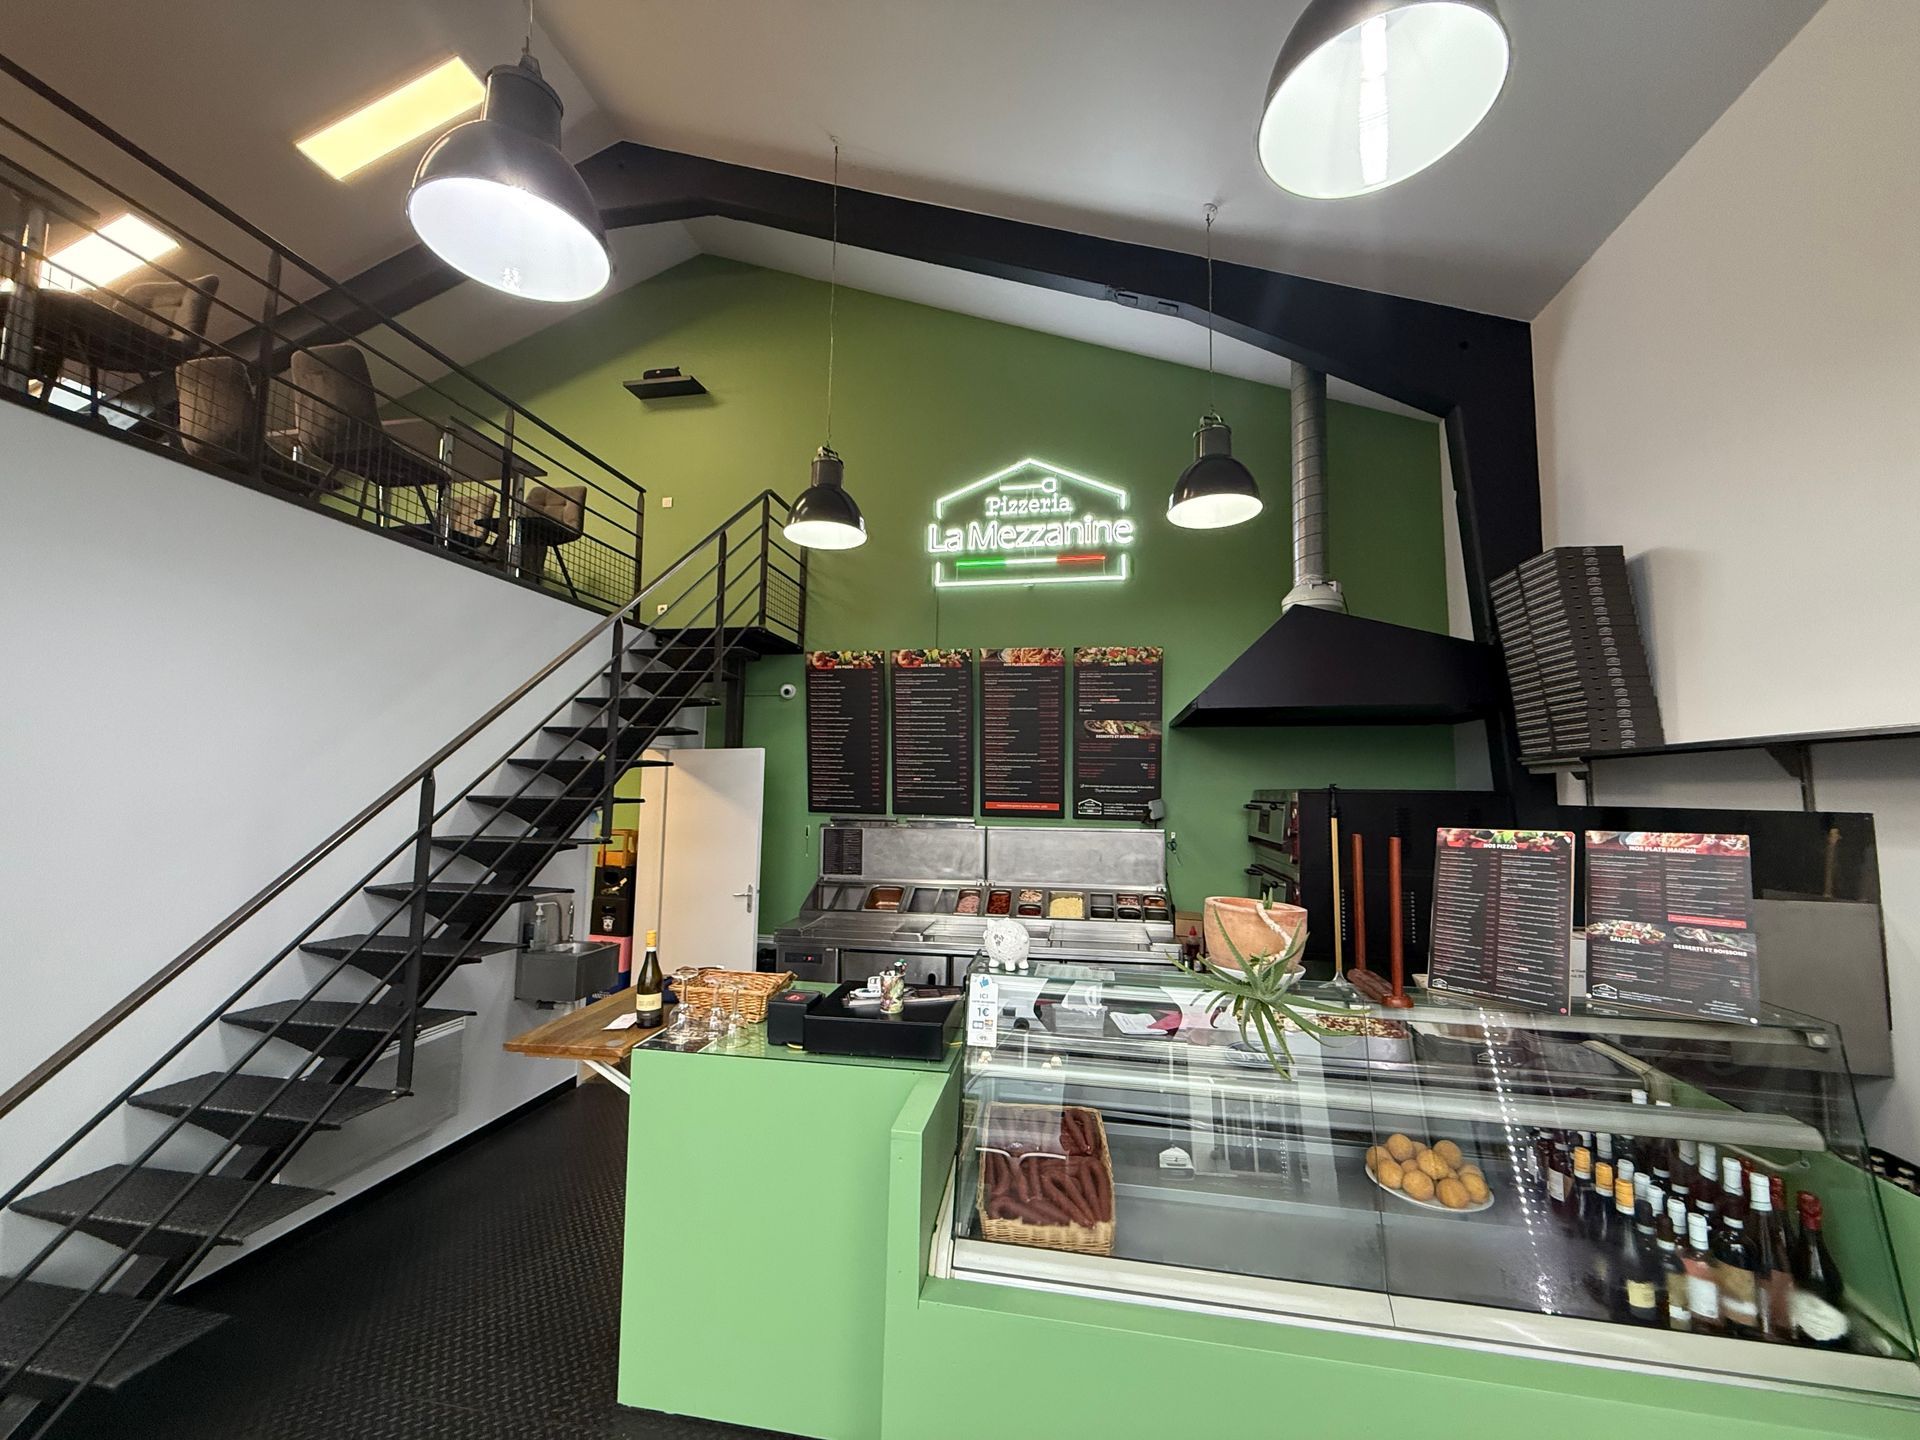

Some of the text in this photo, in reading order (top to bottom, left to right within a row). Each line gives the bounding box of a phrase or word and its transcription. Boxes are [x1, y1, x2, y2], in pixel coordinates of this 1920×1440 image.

[985, 492, 1073, 517] Pizzeria
[926, 513, 1135, 553] La Mezzanine
[1609, 936, 1640, 945] SALADES
[1672, 943, 1704, 952] DESSERTS
[1713, 948, 1748, 957] BOISSONS
[977, 1007, 990, 1017] 1€
